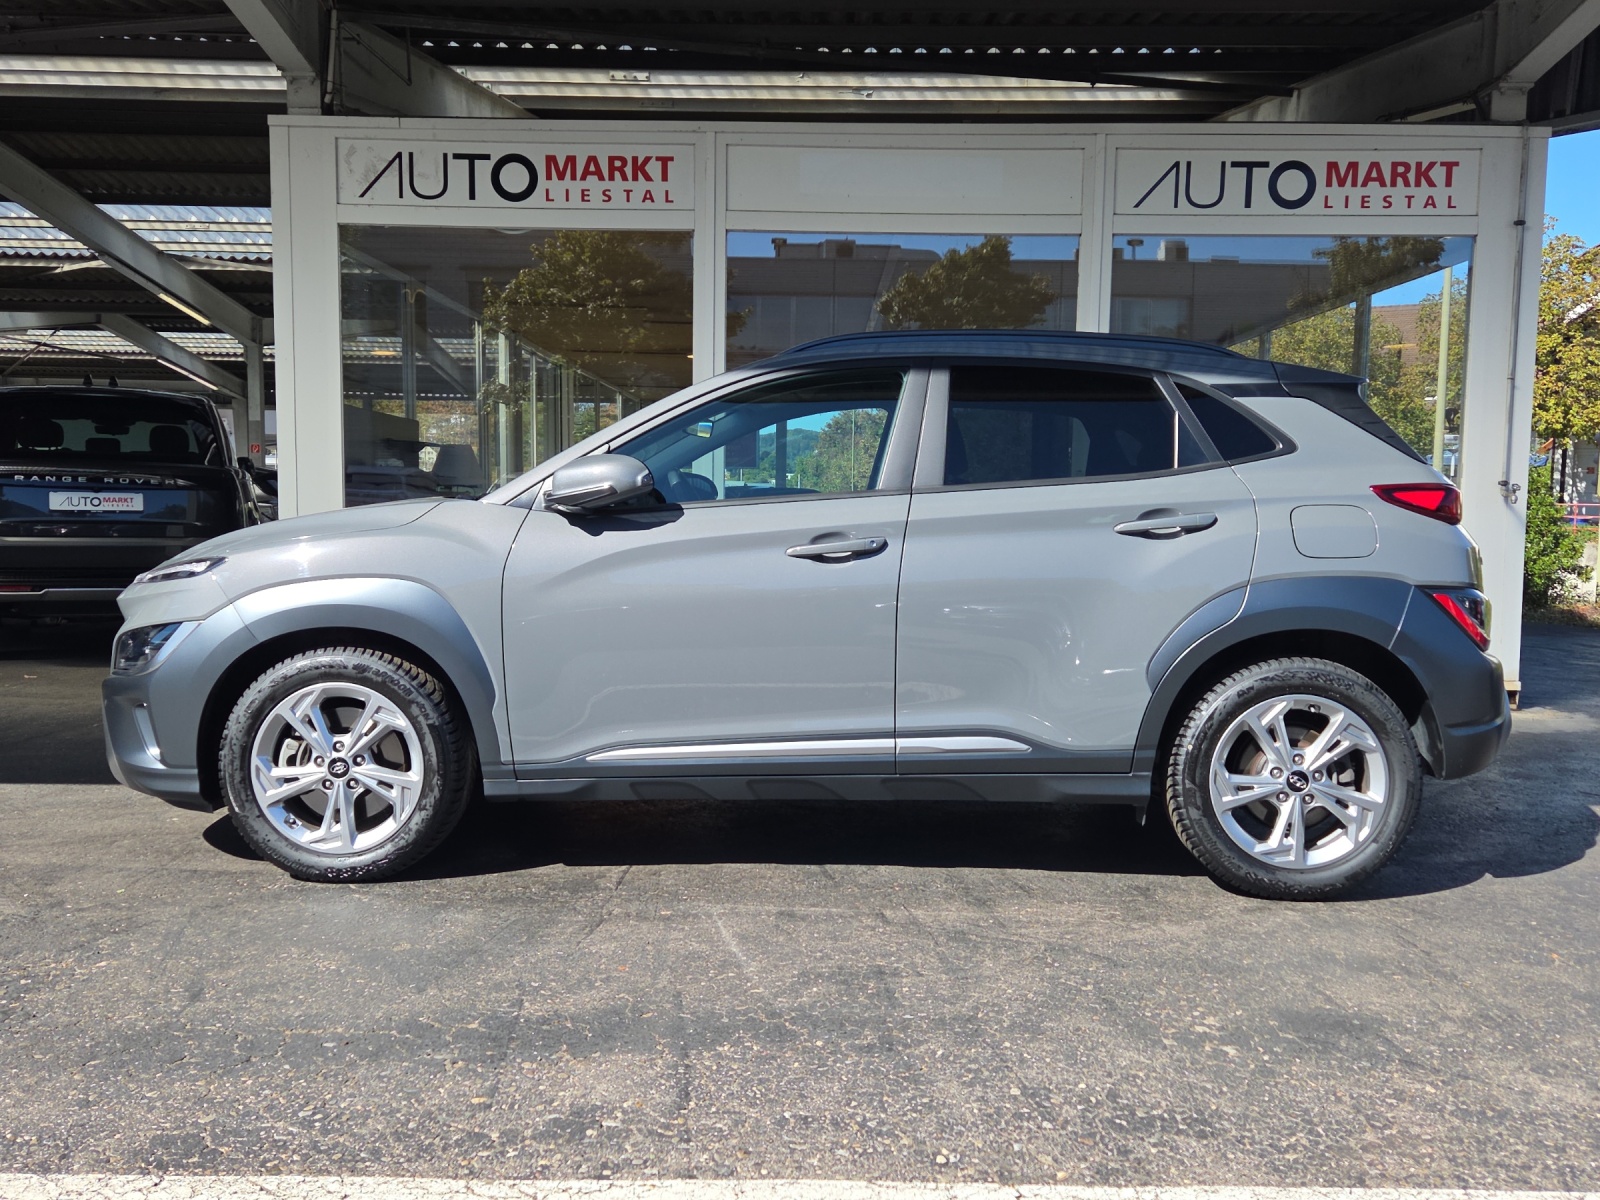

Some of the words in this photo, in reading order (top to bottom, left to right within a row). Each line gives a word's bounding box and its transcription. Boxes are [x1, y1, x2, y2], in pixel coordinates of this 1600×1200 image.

[359, 151, 538, 202] AUTO
[545, 155, 675, 182] MARKT
[1133, 159, 1317, 210] AUTO
[1325, 161, 1460, 188] MARKT
[545, 188, 674, 203] LIESTAL
[1324, 195, 1458, 209] LIESTAL
[14, 475, 87, 483] RANGE
[104, 477, 175, 485] ROVER
